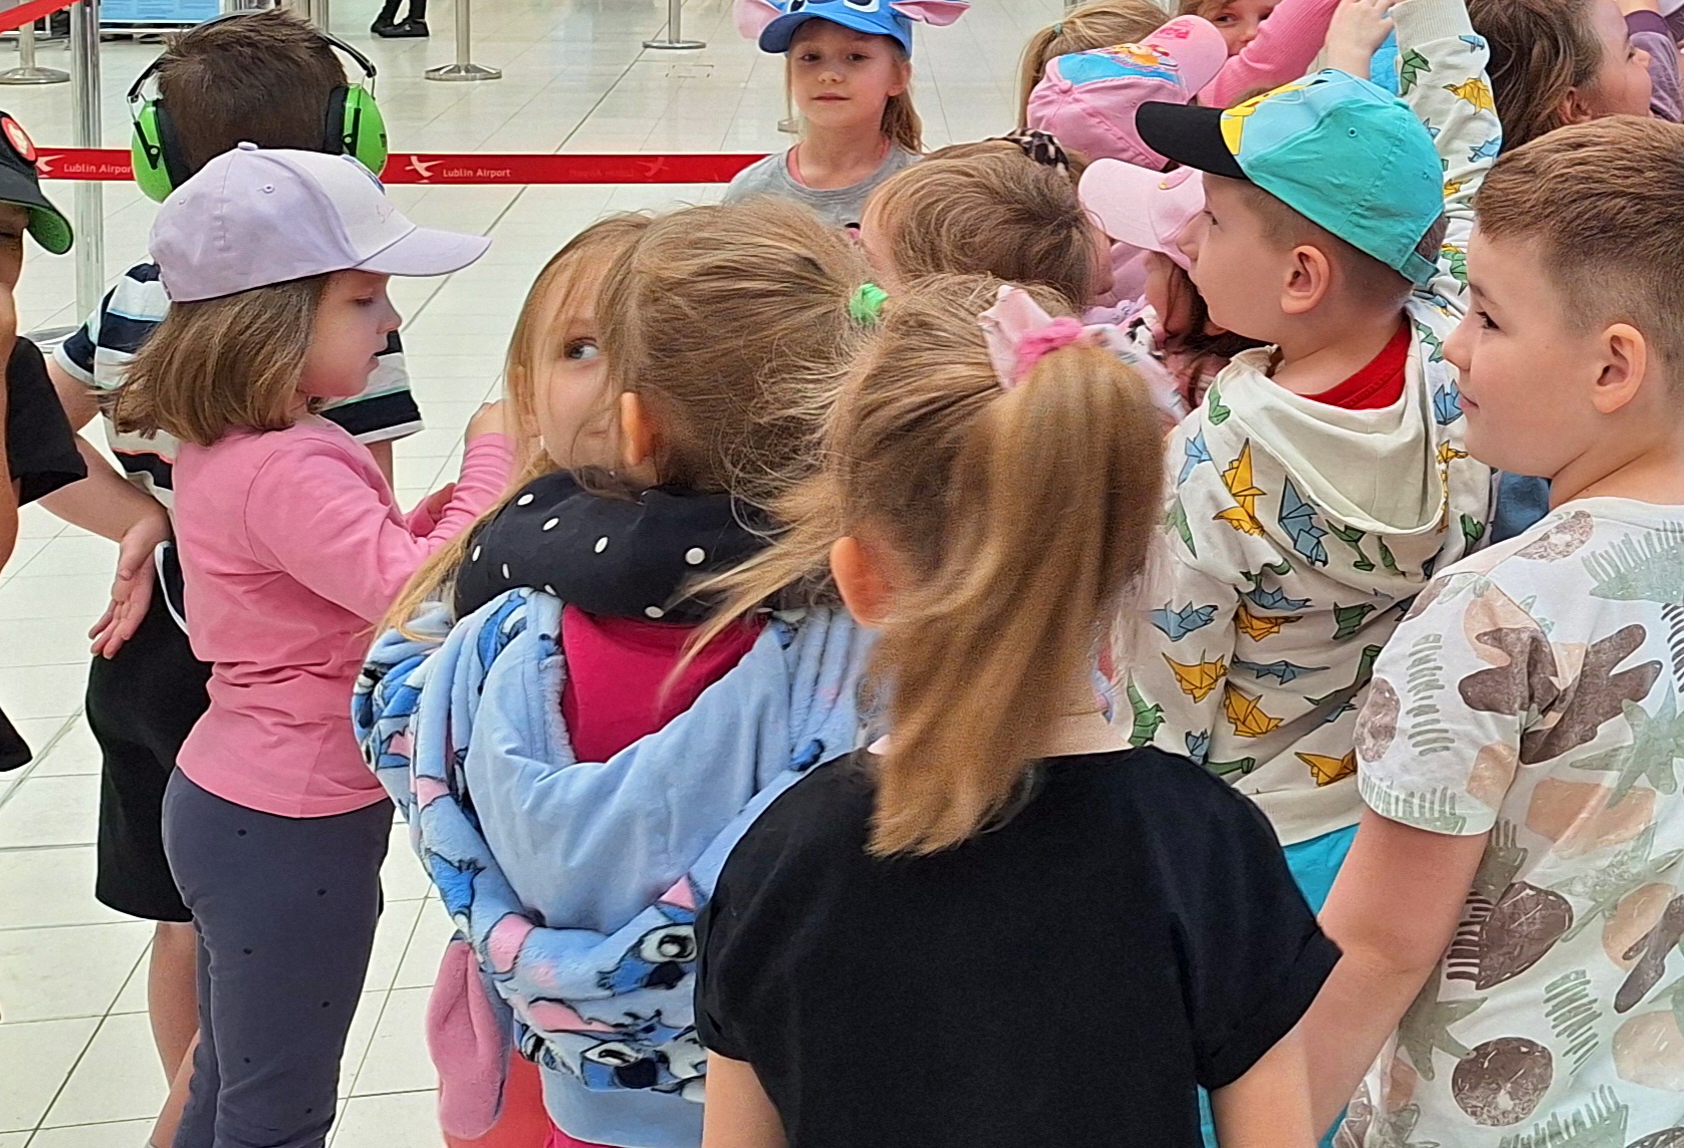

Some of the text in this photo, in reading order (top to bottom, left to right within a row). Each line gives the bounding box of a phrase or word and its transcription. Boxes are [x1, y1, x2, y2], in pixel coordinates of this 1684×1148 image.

[63, 164, 131, 175] Lublin Airpor
[442, 168, 512, 180] Lublin Airport
